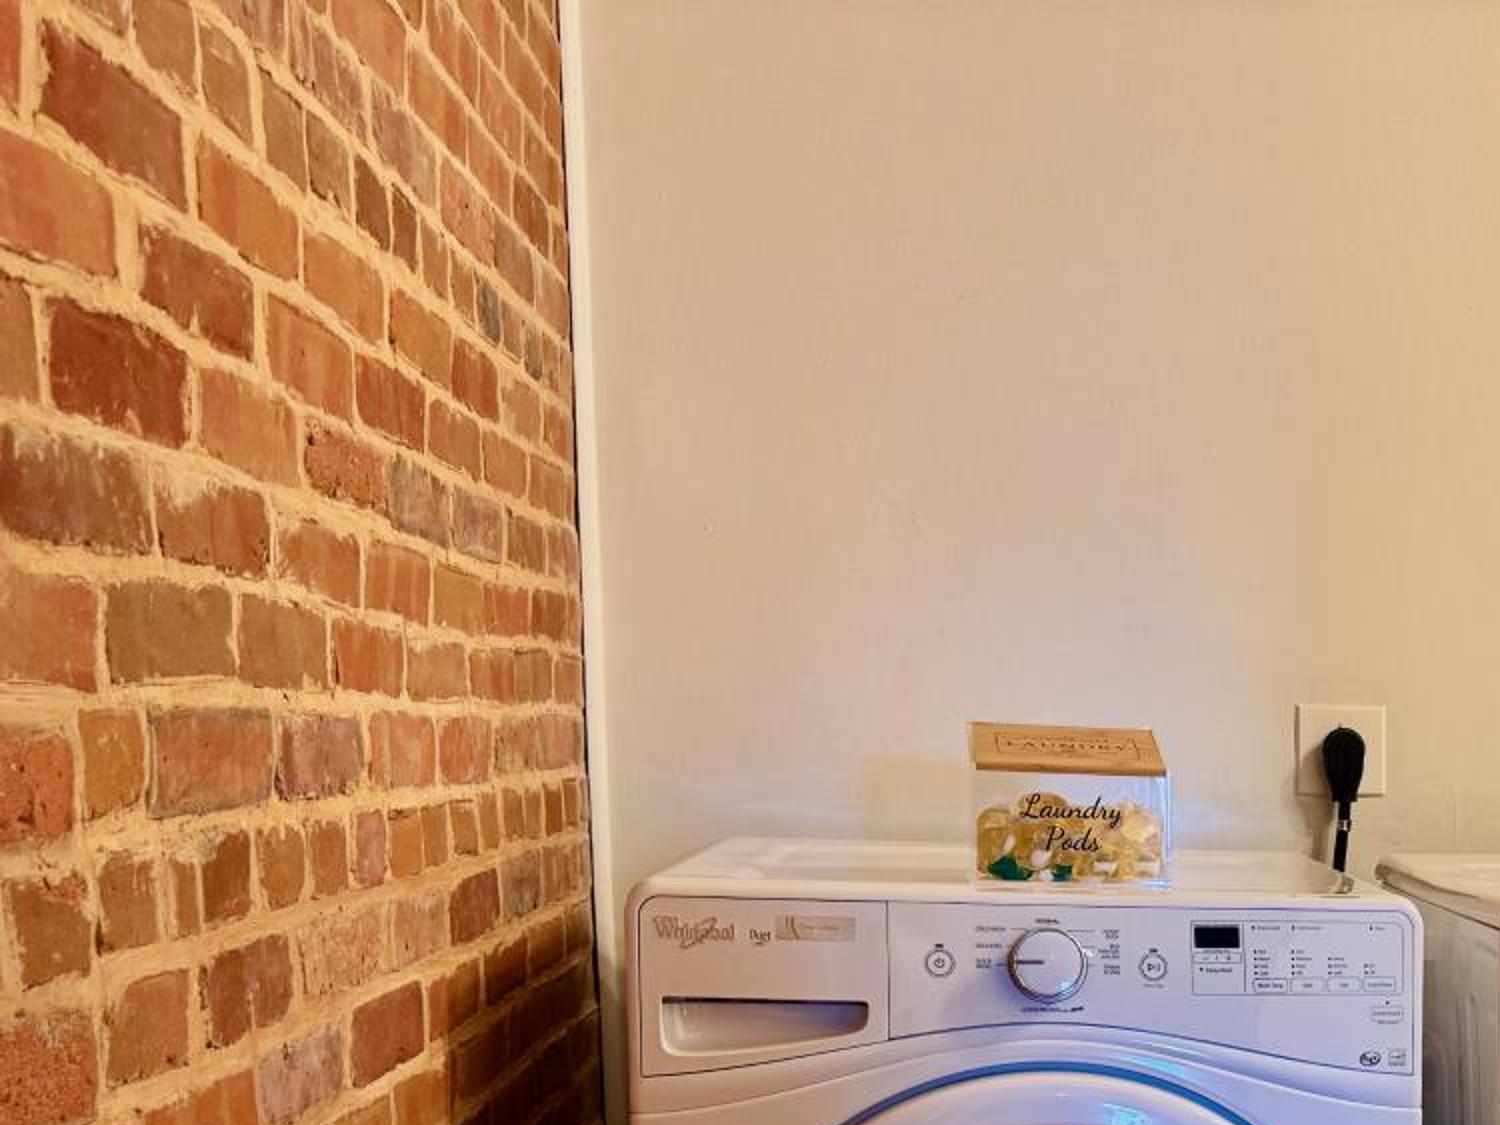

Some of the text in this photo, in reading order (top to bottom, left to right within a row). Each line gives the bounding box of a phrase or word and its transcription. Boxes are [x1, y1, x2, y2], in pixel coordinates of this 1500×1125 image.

[1020, 793, 1121, 829] Laundry
[1044, 826, 1101, 852] Pods
[653, 915, 735, 949] Whirlpool
